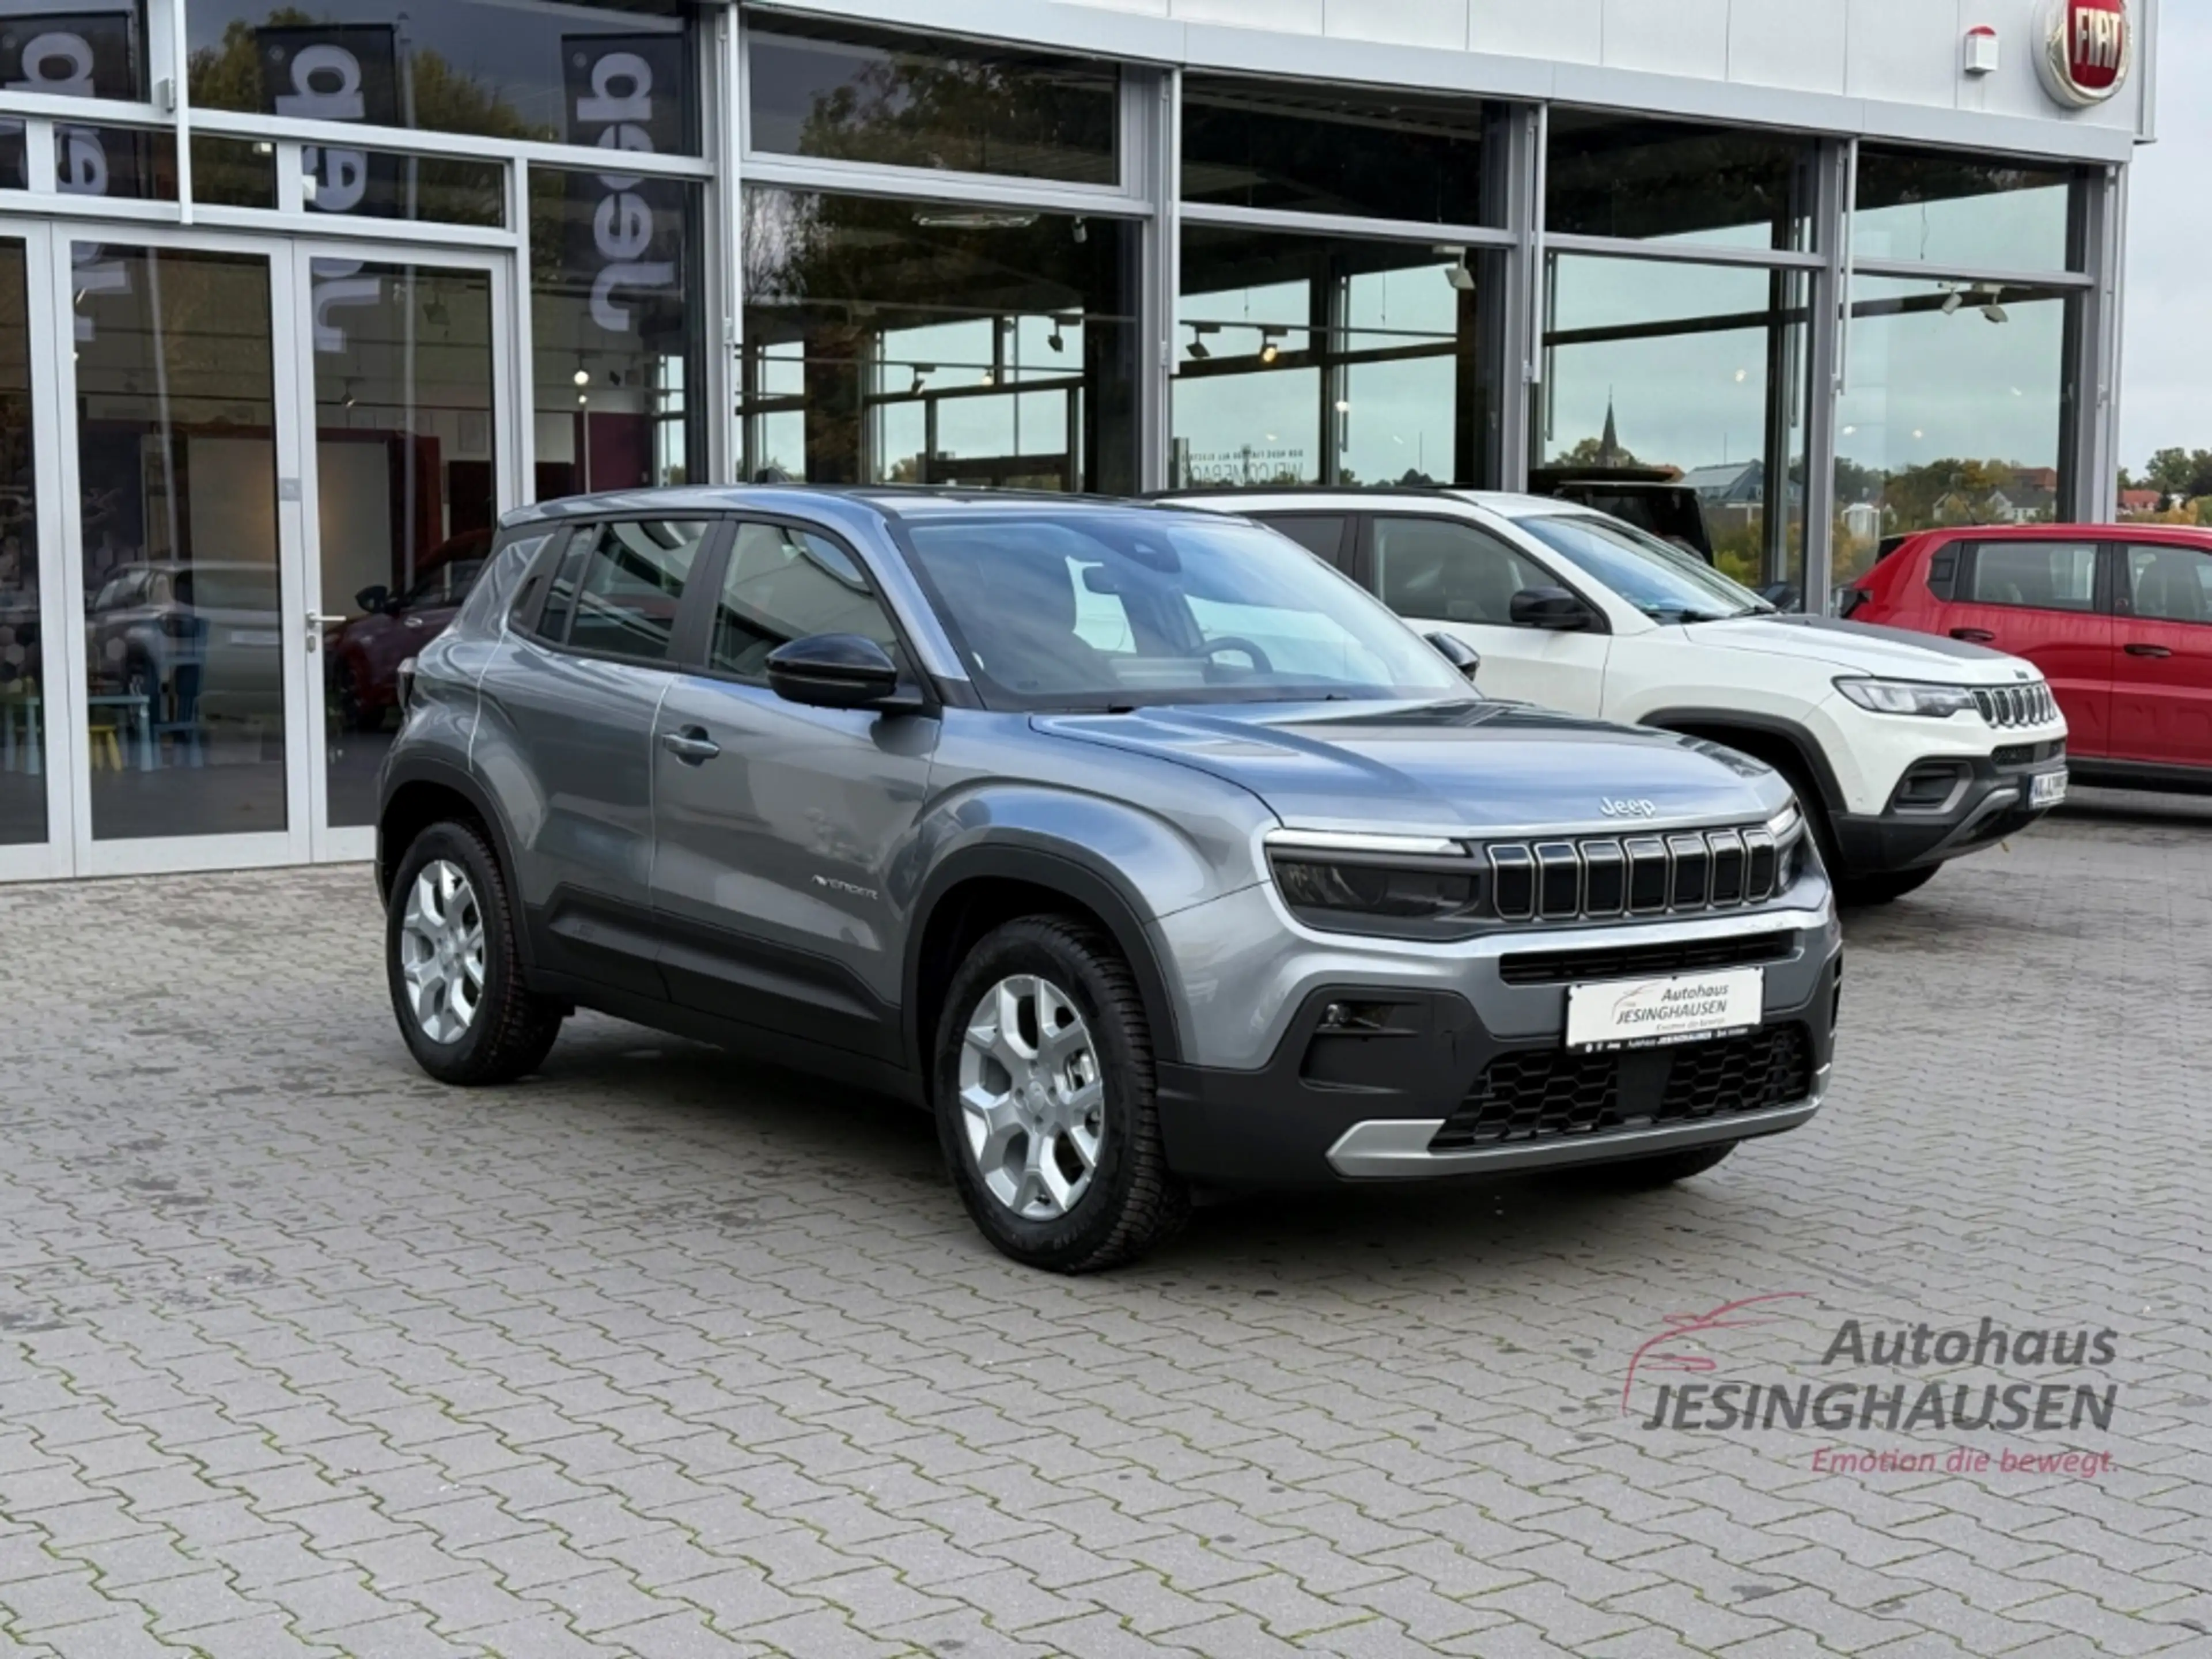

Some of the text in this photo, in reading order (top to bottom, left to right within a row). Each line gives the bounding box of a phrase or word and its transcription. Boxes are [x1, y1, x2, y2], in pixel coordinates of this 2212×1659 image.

[2074, 6, 2120, 70] FIAT
[1599, 797, 1656, 818] Jeep
[1661, 984, 1729, 1002] Autohaus
[1616, 1000, 1728, 1024] JESINGHAUSEN
